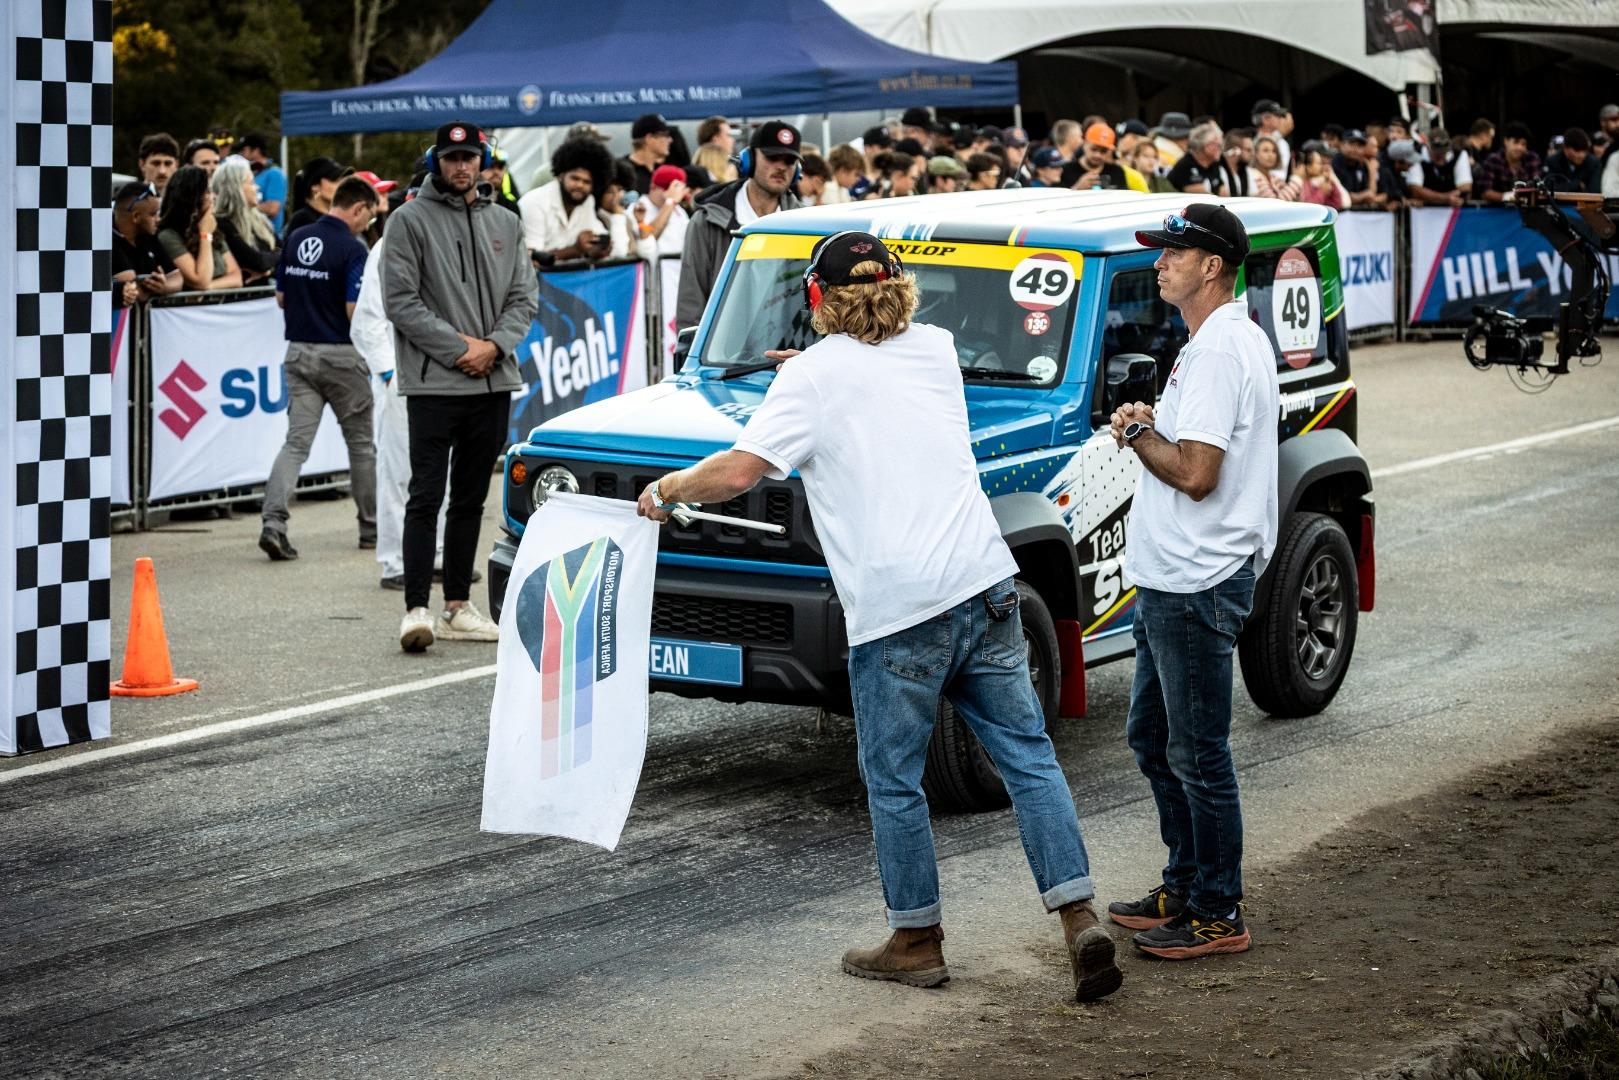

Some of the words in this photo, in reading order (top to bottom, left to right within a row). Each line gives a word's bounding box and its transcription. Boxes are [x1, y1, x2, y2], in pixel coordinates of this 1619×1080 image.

[885, 243, 957, 256] UNLOP
[1017, 267, 1069, 297] 49
[1342, 252, 1392, 286] UZUKI
[1442, 246, 1532, 302] HILL
[1282, 286, 1310, 330] 49
[529, 310, 620, 406] Yeah!
[649, 643, 689, 676] EAN
